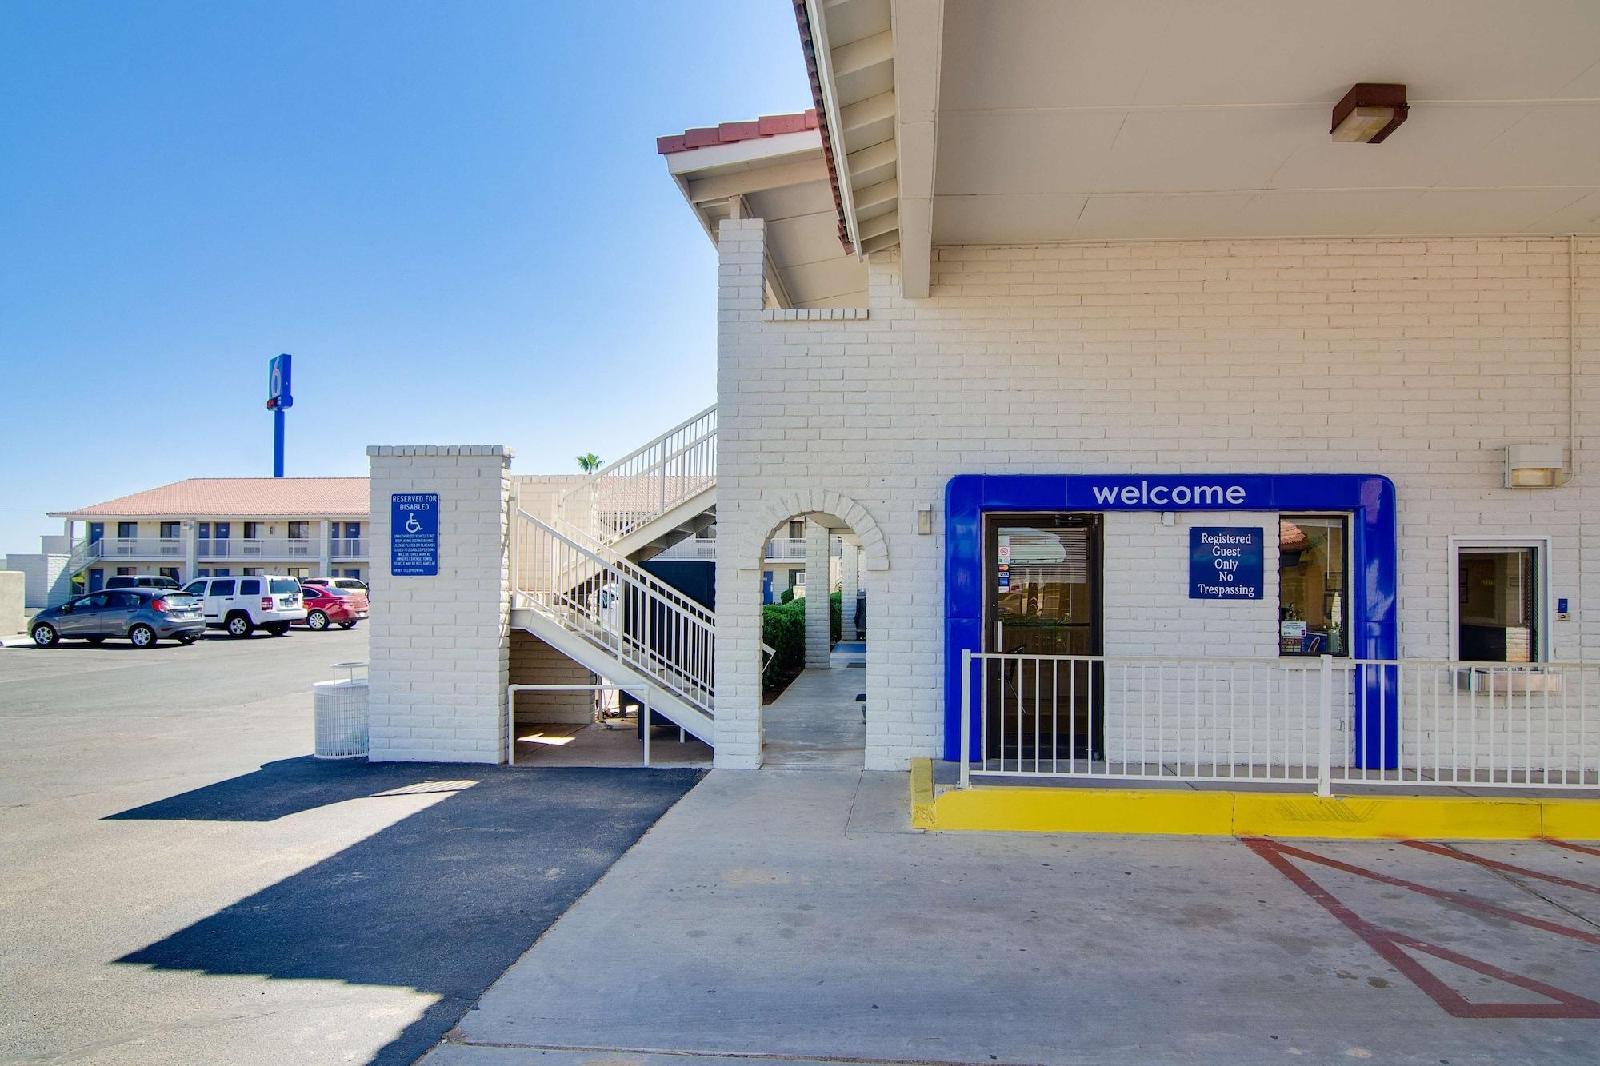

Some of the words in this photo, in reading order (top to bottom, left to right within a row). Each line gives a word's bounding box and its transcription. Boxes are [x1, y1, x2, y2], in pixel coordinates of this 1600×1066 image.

[1093, 480, 1246, 505] welcome
[399, 503, 430, 511] DISABLED
[1201, 532, 1252, 546] Registered
[1212, 545, 1241, 557] Guest
[1214, 558, 1239, 572] Only
[1218, 571, 1234, 582] No
[1197, 583, 1255, 598] Trespassing
